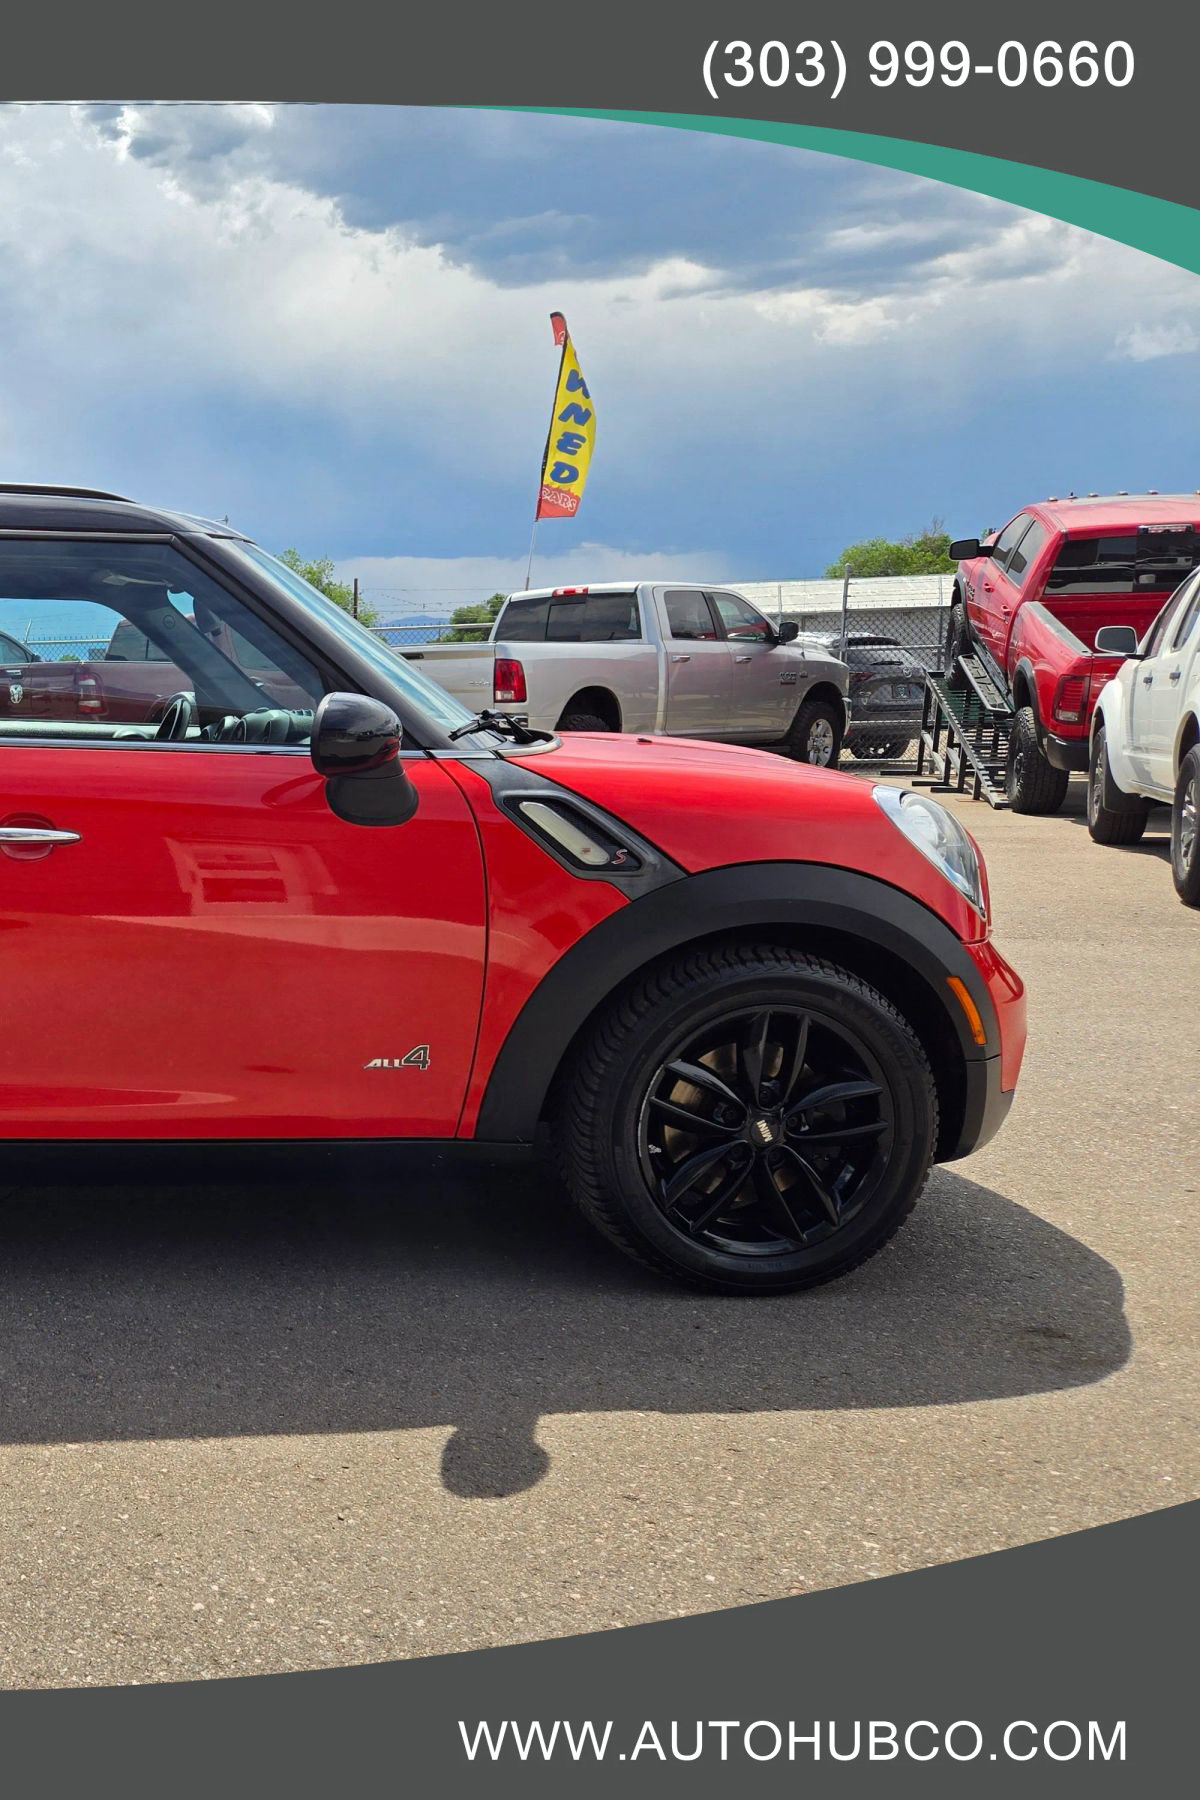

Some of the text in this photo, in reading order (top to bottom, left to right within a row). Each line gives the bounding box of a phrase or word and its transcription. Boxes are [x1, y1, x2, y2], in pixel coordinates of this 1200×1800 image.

[611, 848, 628, 865] S
[363, 1044, 431, 1071] ALL4
[756, 1119, 774, 1143] MINI
